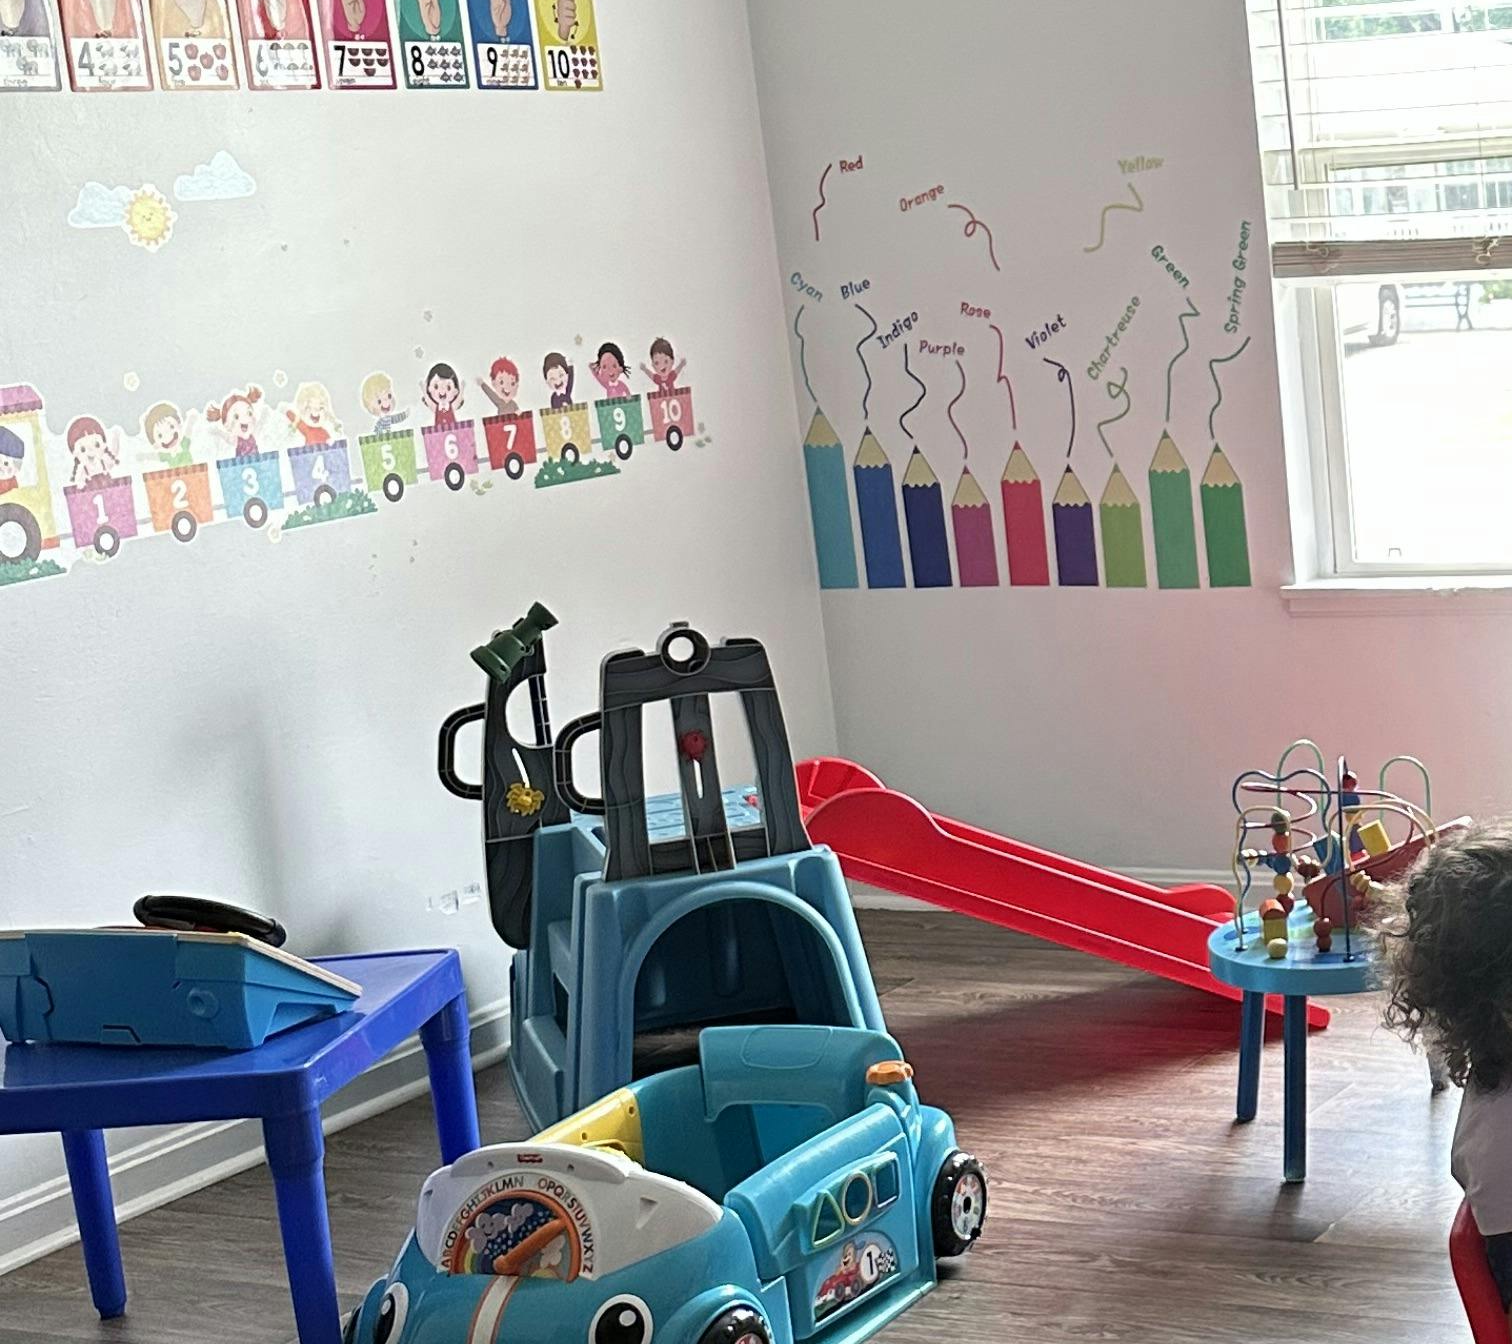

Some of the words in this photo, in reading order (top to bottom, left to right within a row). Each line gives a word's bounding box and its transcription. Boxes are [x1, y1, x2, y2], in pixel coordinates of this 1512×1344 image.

[78, 41, 95, 76] 4
[168, 42, 183, 76] 5
[333, 45, 346, 77] 7
[410, 45, 425, 76] 8
[486, 47, 498, 77] 9
[547, 50, 570, 79] 10
[838, 155, 864, 173] Red
[1117, 156, 1165, 175] Yellow
[899, 184, 945, 212] Orange
[1232, 220, 1252, 271] Green
[1150, 244, 1190, 289] Green
[790, 271, 823, 302] Cyan
[840, 279, 871, 300] Blue
[960, 301, 992, 319] Rose
[1224, 277, 1246, 334] Spring
[875, 311, 919, 350] Indigo
[1024, 313, 1067, 350] Violet
[1087, 296, 1141, 381] Chartreuse
[918, 340, 965, 357] Purple
[612, 407, 626, 431] 9
[659, 399, 682, 424] 10
[503, 424, 517, 450] 7
[560, 416, 572, 440] 8
[381, 444, 396, 471] 5
[444, 433, 459, 460] 6
[241, 467, 260, 496] 3
[312, 459, 329, 482] 4
[92, 493, 109, 524] 1
[170, 479, 189, 509] 2
[866, 1251, 874, 1275] 1
